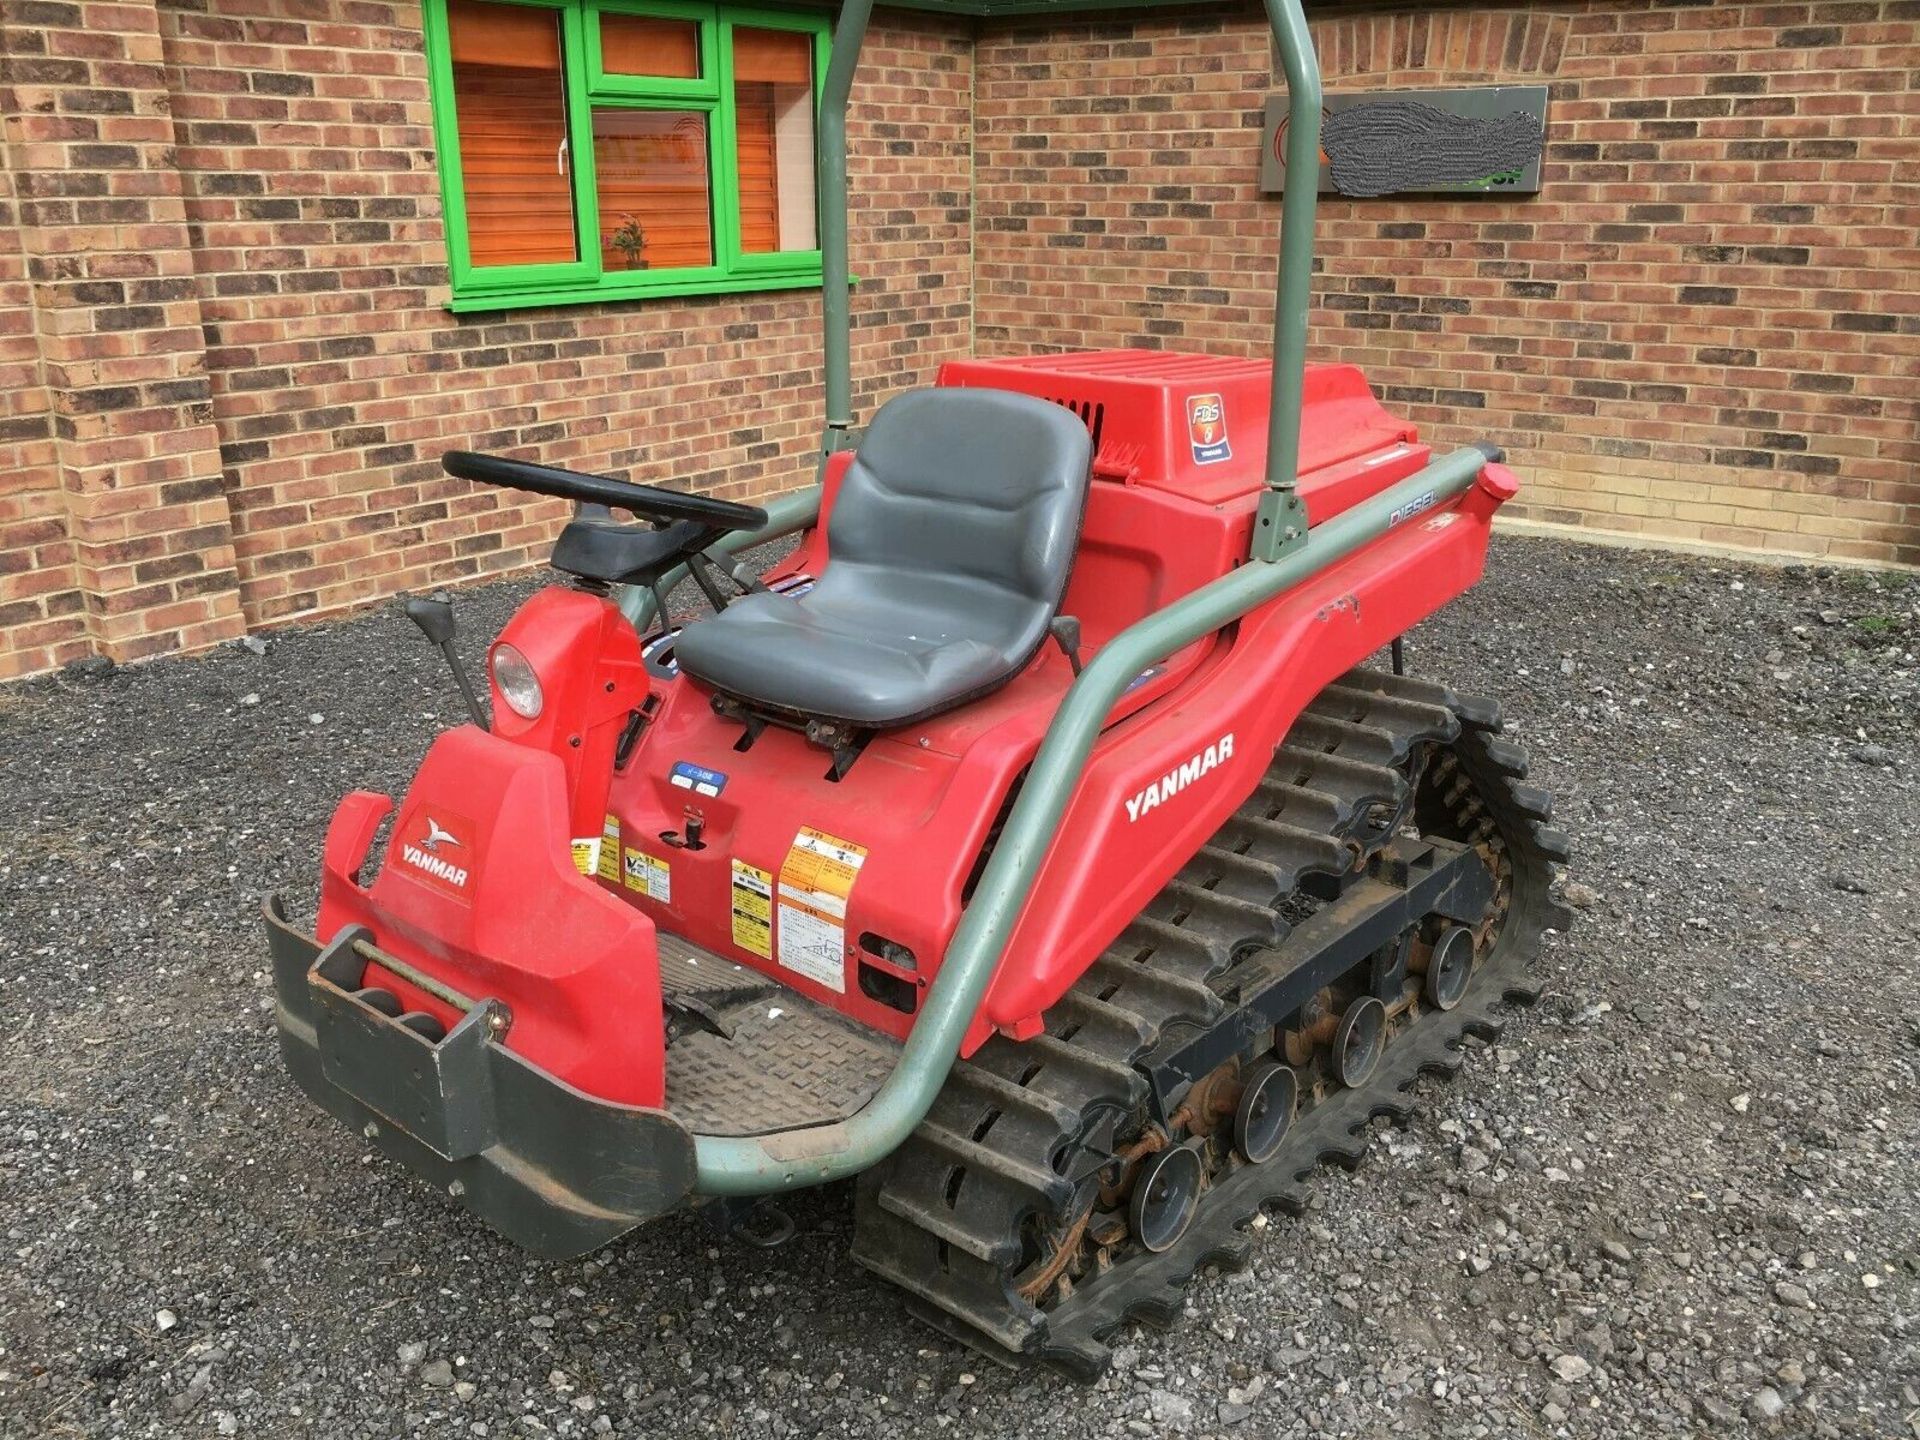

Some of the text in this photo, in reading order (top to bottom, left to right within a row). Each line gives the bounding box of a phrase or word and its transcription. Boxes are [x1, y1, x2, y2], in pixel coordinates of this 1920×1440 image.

[1388, 489, 1437, 529] DIESEL
[1125, 733, 1234, 823] YANMAR
[402, 844, 468, 887] YANMAR
